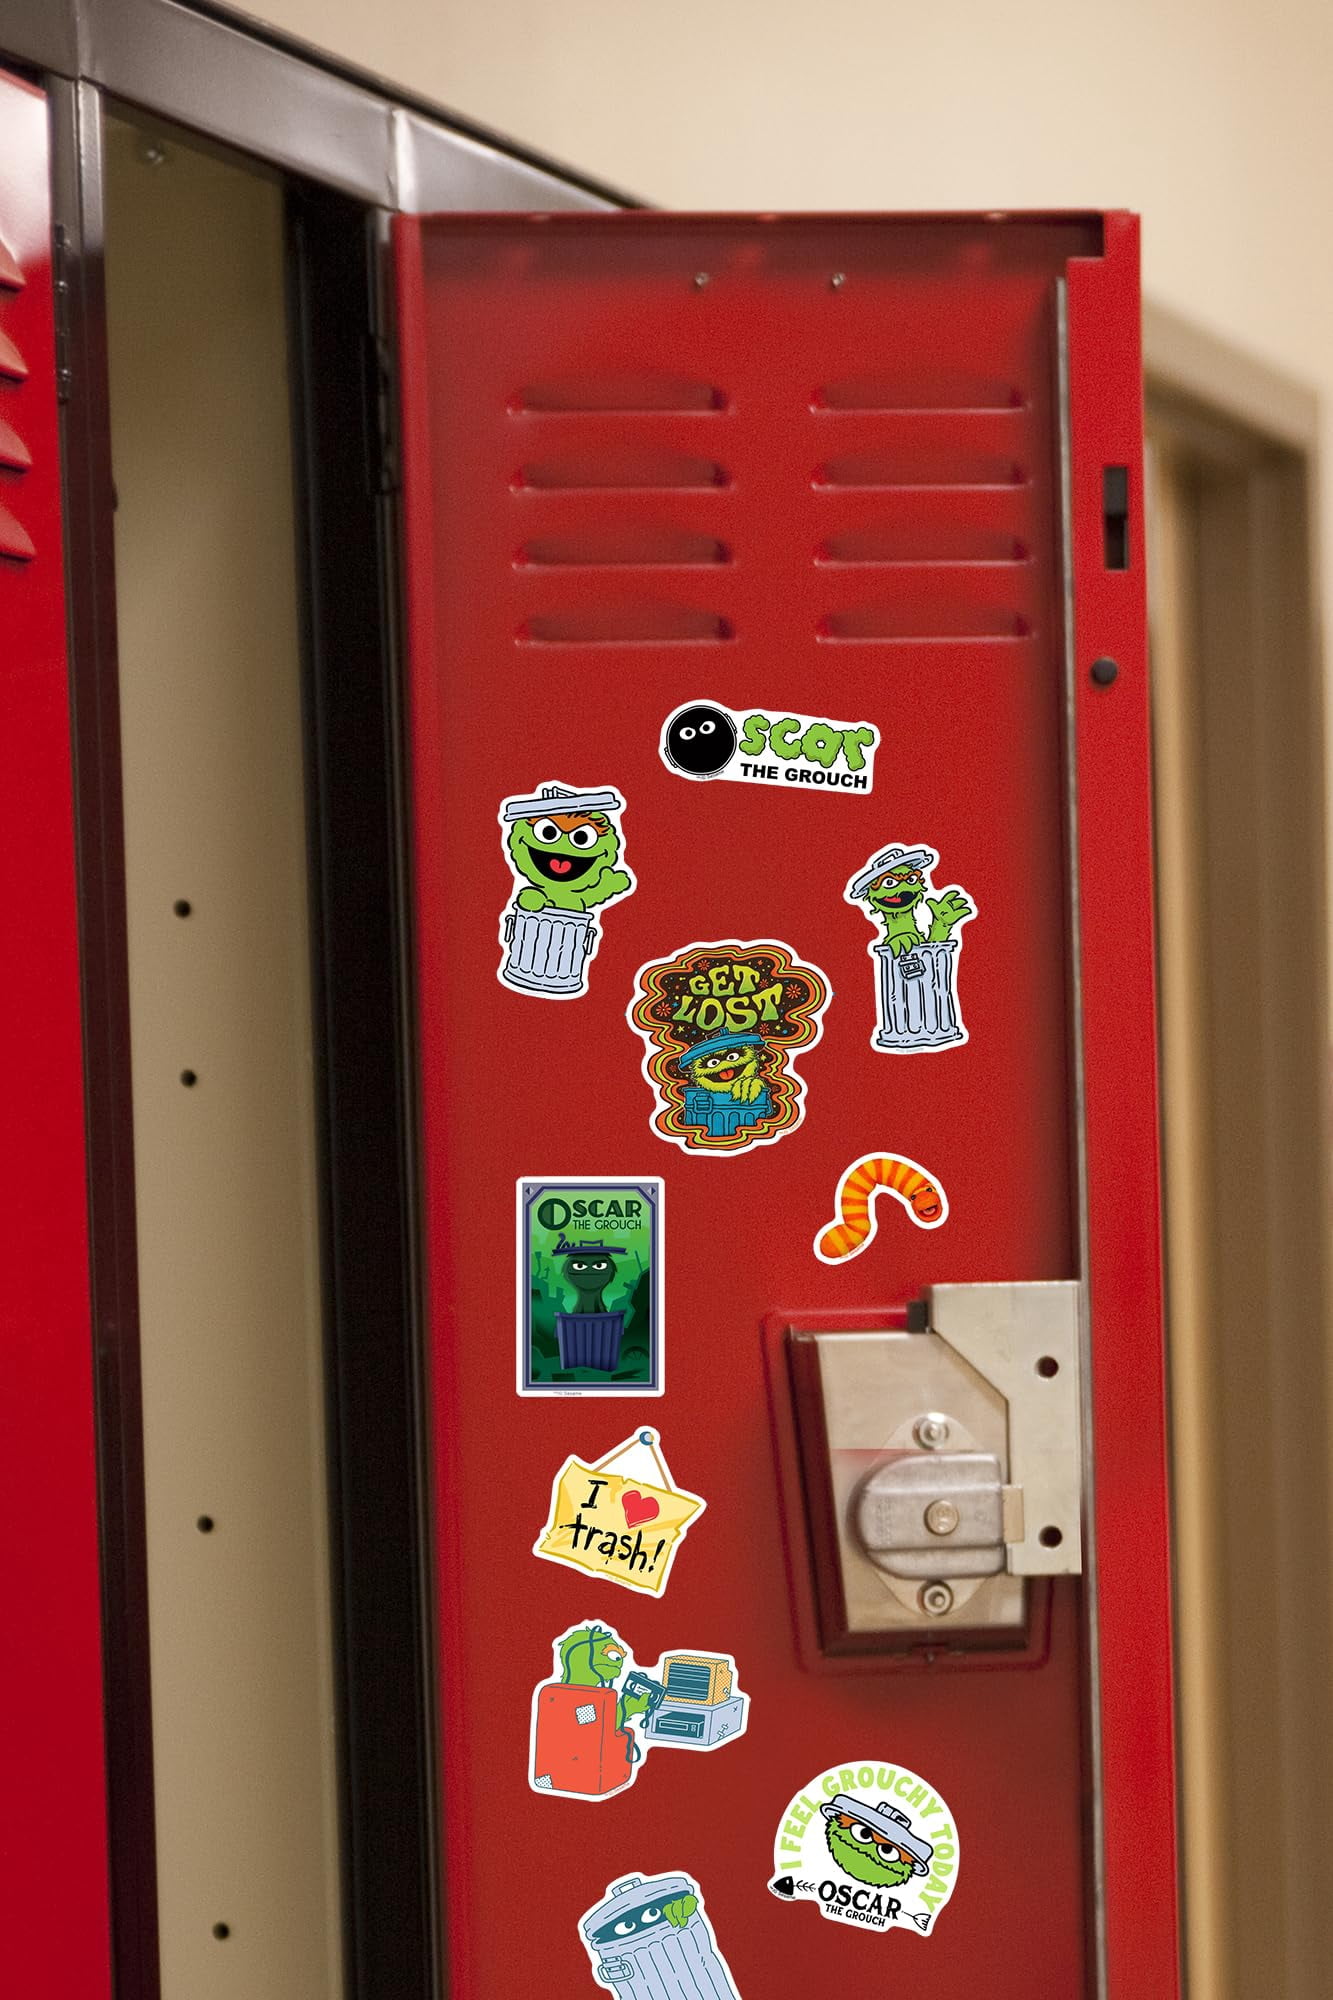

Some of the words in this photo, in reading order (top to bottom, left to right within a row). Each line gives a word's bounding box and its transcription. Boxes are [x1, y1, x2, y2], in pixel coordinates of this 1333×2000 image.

[740, 763, 779, 780] THE
[785, 768, 868, 789] GROUCH
[689, 965, 760, 997] GET
[673, 983, 784, 1032] LOST
[537, 1198, 642, 1231] OSCAR
[573, 1219, 591, 1230] THE
[594, 1219, 642, 1230] GROUCH
[581, 1479, 608, 1509] I
[559, 1513, 665, 1573] trash!
[822, 1766, 943, 1818] GROUCHY
[781, 1795, 823, 1853] FEEL
[780, 1860, 802, 1870] I
[918, 1824, 955, 1913] TODAY
[818, 1880, 902, 1920] OSCAR
[825, 1903, 843, 1917] THE
[845, 1909, 886, 1927] GROUCH
